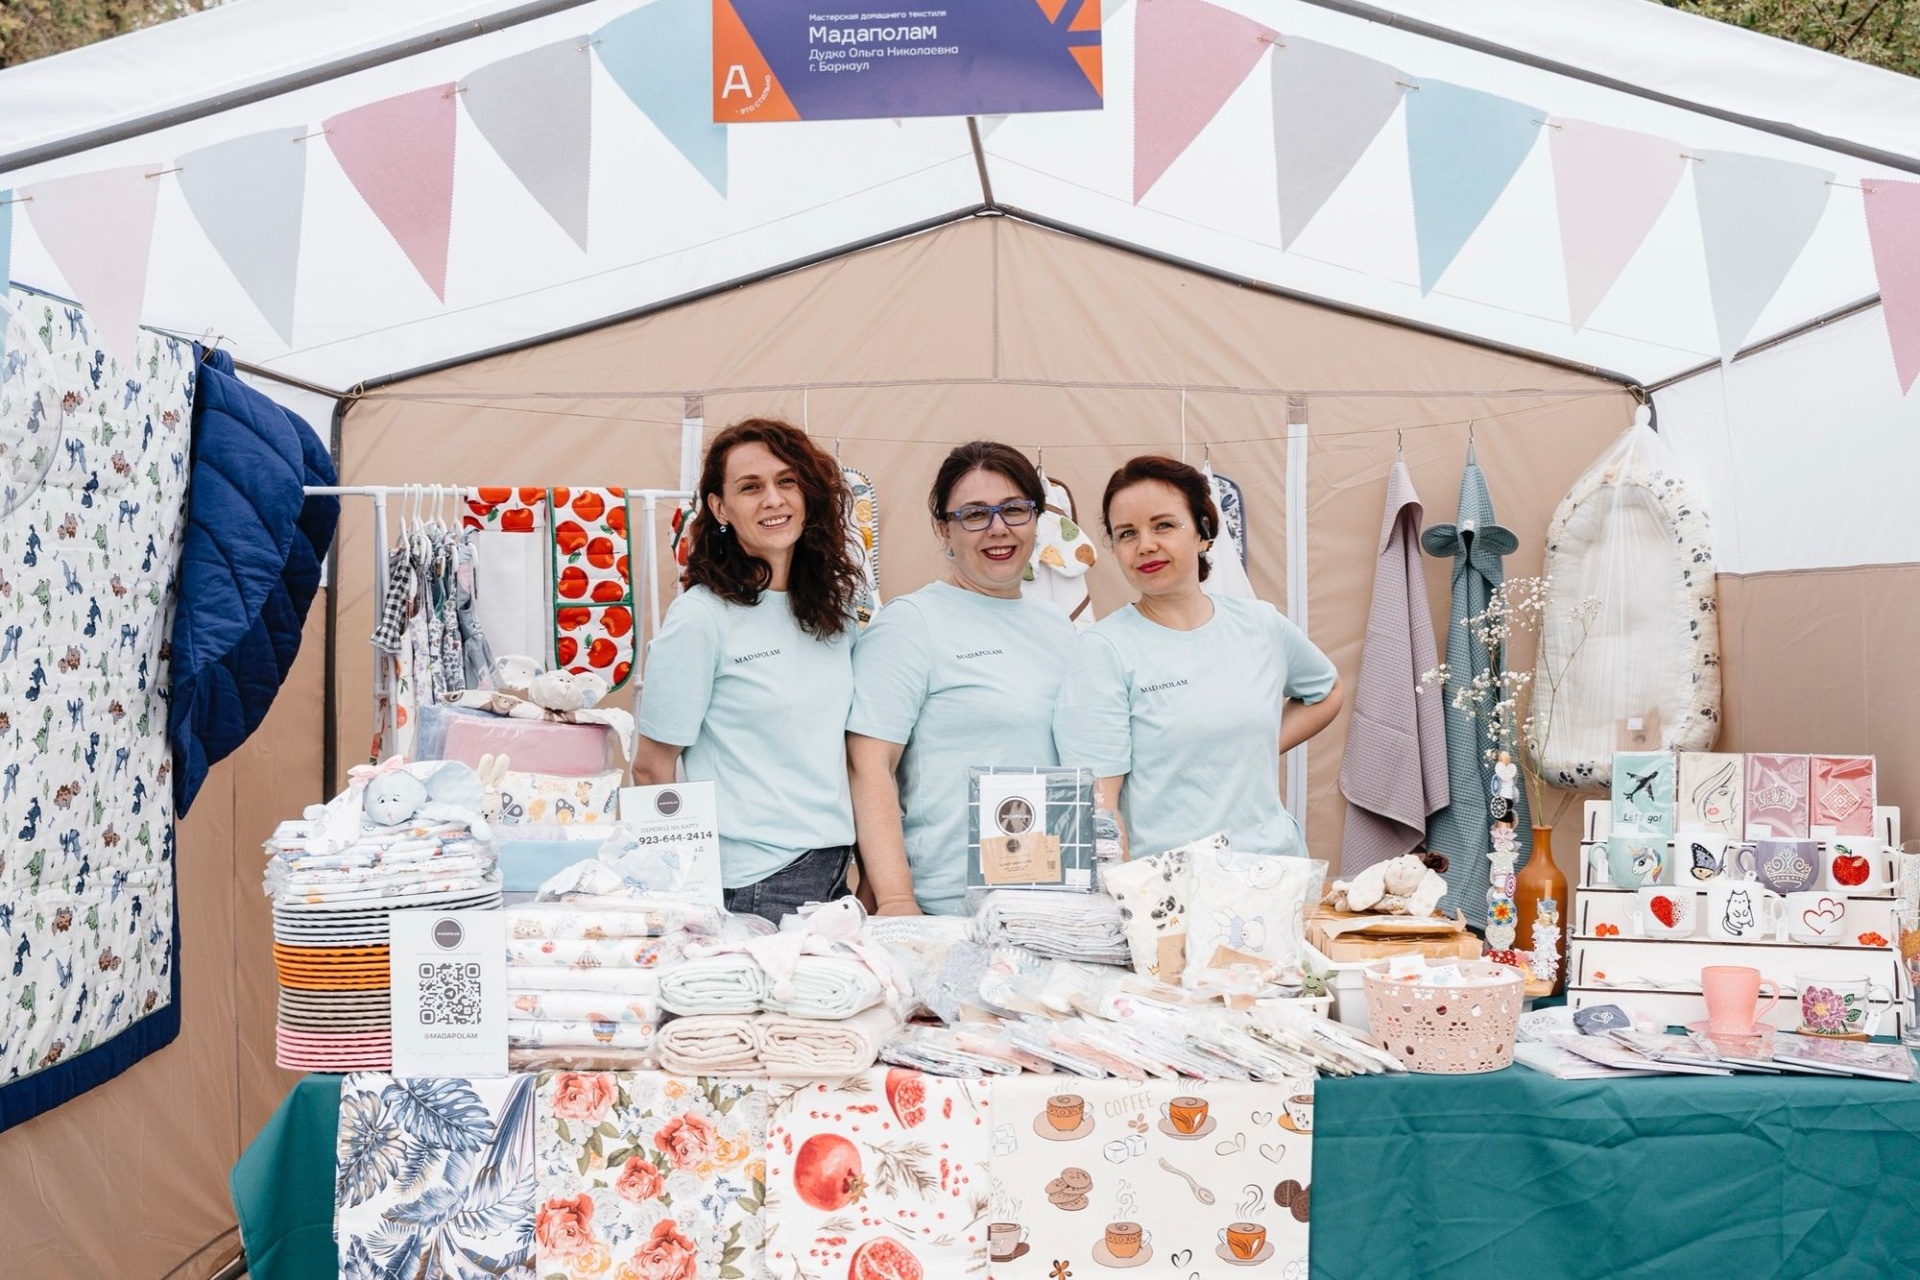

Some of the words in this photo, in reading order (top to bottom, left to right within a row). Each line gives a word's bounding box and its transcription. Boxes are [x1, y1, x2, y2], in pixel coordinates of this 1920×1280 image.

[809, 13, 859, 22] Мастерская
[860, 11, 907, 20] домашнего
[908, 10, 947, 18] текстиля
[809, 25, 937, 45] Мадаполам
[808, 49, 846, 61] Дудко
[849, 47, 884, 58] Ольга
[887, 46, 959, 57] Николаевна
[809, 64, 817, 72] г.
[819, 61, 870, 73] Барнаул
[734, 648, 781, 665] MADAPOLAM
[956, 649, 1003, 660] MADAPOLAM
[1140, 679, 1188, 694] MADAPOLAM
[1647, 814, 1662, 824] go!
[638, 830, 713, 846] 923-644-2414
[424, 1032, 478, 1040] @MADAPOLAM
[1104, 1090, 1155, 1118] COFFEE
